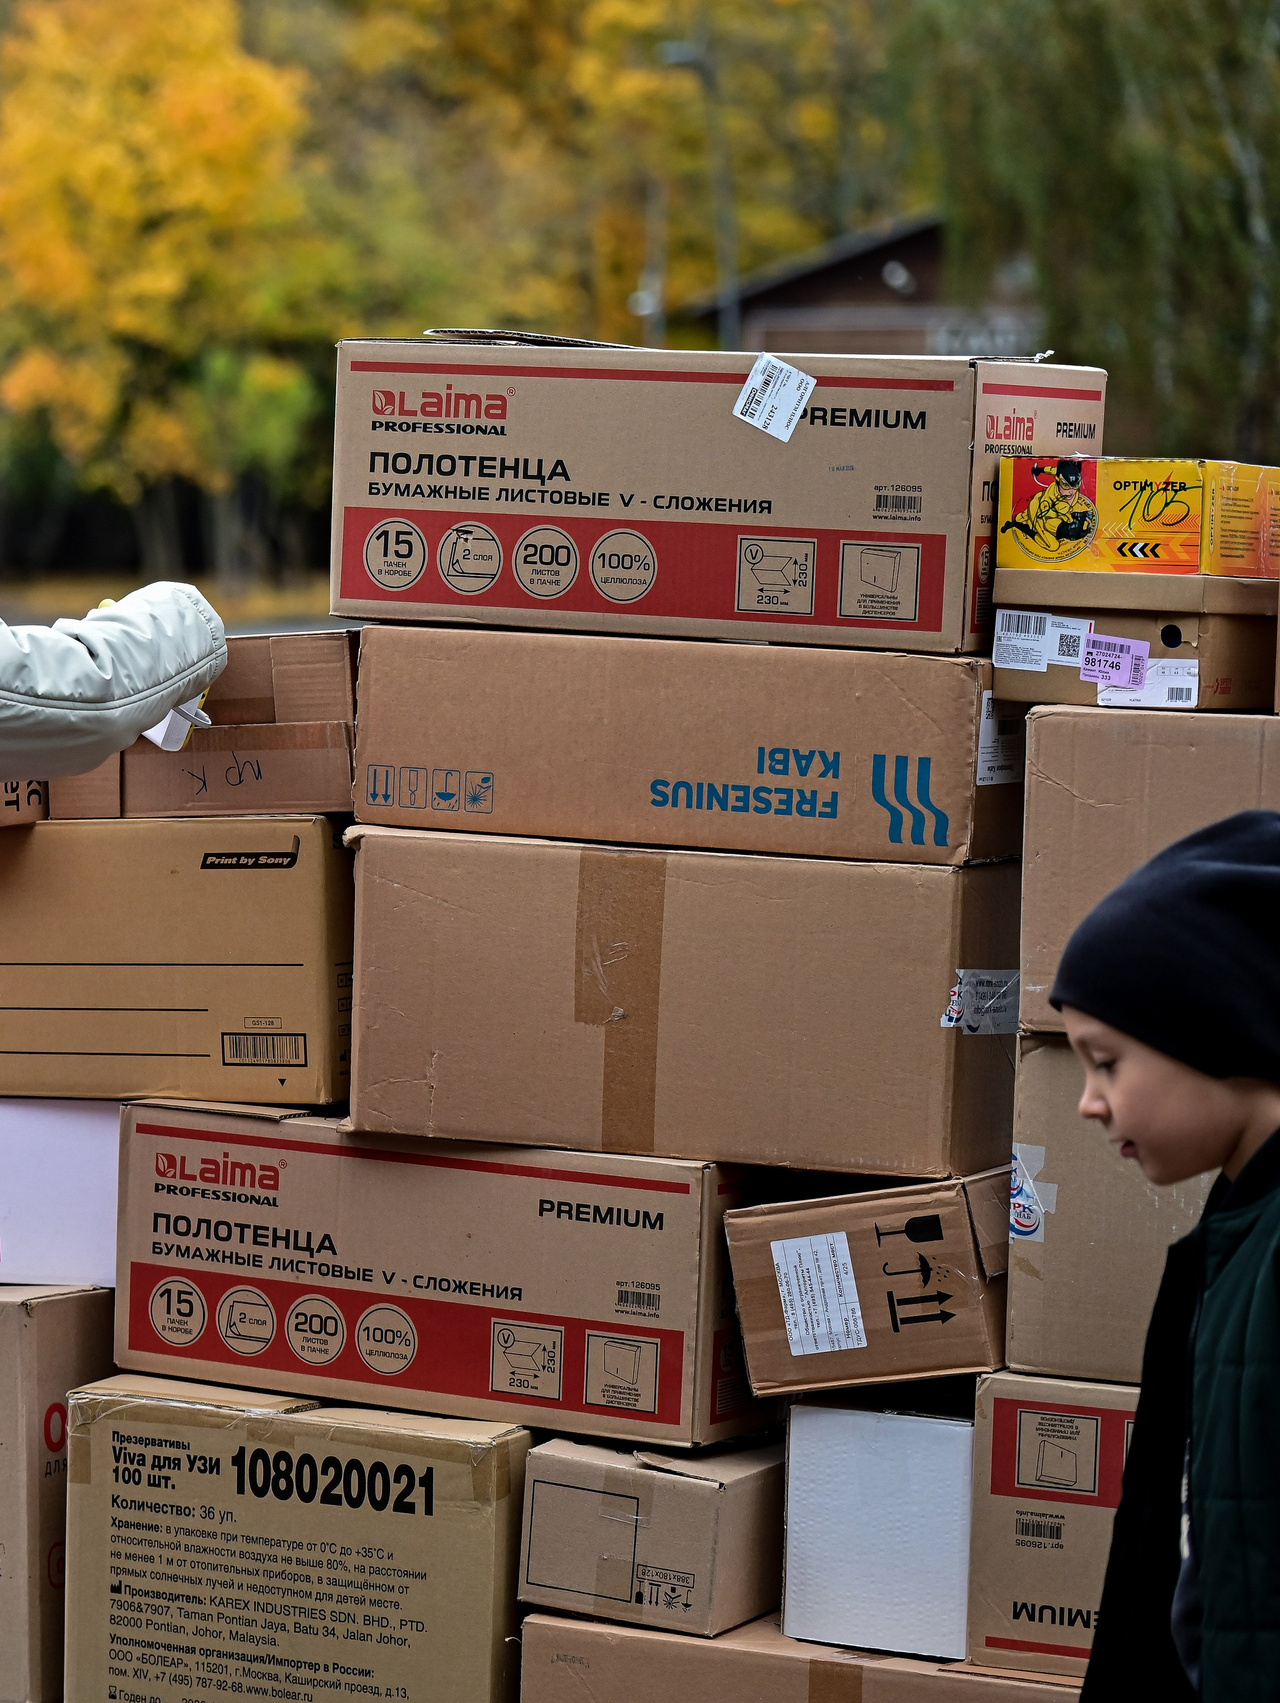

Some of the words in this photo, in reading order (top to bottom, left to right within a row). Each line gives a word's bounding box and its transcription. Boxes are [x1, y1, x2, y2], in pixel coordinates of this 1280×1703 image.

[398, 383, 508, 420] Laima
[371, 420, 507, 437] PROFESSIONAL
[994, 408, 1035, 441] Laima
[1055, 421, 1096, 440] PREMIUM
[984, 443, 1033, 455] PROFESSIONAL
[369, 451, 571, 485] ПОЛОТЕНЦА
[368, 481, 490, 501] БУМАЖНЫЕ
[495, 487, 610, 507] ЛИСТОВЫЕ
[619, 493, 635, 508] V
[653, 495, 772, 515] СЛОЖЕНИЯ
[873, 484, 923, 493] арт.126095
[375, 529, 413, 559] 15
[462, 548, 471, 561] 2
[472, 553, 493, 562] СЛОЯ
[523, 543, 571, 567] 200
[377, 568, 383, 576] В
[384, 569, 412, 577] КОРОБЕ
[383, 560, 407, 569] ПАЧЕК
[531, 568, 560, 577] ЛИСТОВ
[597, 552, 651, 571] 100%
[529, 577, 535, 585] В
[536, 578, 561, 587] ПАЧКЕ
[600, 577, 648, 587] ЦЕЛЛЮЛОЗА
[797, 563, 808, 588] 230
[756, 594, 779, 606] 230
[1084, 656, 1121, 671] 981746
[756, 746, 841, 780] KABI
[649, 778, 839, 820] FRESENIUS
[206, 856, 238, 864] Print
[239, 856, 256, 866] by
[257, 855, 291, 865] Sony
[180, 1151, 280, 1192] Laima
[154, 1182, 279, 1208] PROFESSIONAL
[538, 1198, 664, 1231] PREMIUM
[152, 1212, 338, 1259] ПОЛОТЕНЦА
[151, 1241, 263, 1268] БУМАЖНЫЕ
[268, 1256, 374, 1283] ЛИСТОВЫЕ
[381, 1270, 396, 1285] V
[412, 1274, 523, 1302] СЛОЖЕНИЯ
[615, 1280, 661, 1291] арт.126095
[158, 1287, 194, 1318] 15
[294, 1312, 343, 1337] 200
[362, 1326, 412, 1347] 100%
[112, 1430, 191, 1451] Презервативы
[111, 1445, 147, 1467] Viva
[150, 1454, 182, 1471] для
[186, 1453, 221, 1476] УЗИ
[112, 1465, 142, 1486] 100
[147, 1473, 176, 1490] шт.
[231, 1445, 434, 1517] 108020021
[111, 1493, 196, 1518] Количество:
[199, 1505, 215, 1520] 36
[218, 1510, 237, 1525] уп.
[1015, 1538, 1064, 1550] арт.126095
[641, 1568, 691, 1585] 388x180x128
[124, 1584, 207, 1606] Производитель:
[209, 1595, 251, 1611] KAREX
[253, 1600, 327, 1621] INDUSTRIES
[329, 1610, 359, 1625] SDN.
[363, 1614, 396, 1631] BHD.,
[399, 1618, 428, 1633] PTD.
[1012, 1601, 1102, 1631] MIUM
[109, 1598, 174, 1619] 7906&7907,
[176, 1606, 214, 1623] Taman
[216, 1611, 258, 1628] Pontian
[260, 1617, 290, 1634] Jaya,
[293, 1621, 319, 1636] Batu
[321, 1625, 339, 1640] 34,
[342, 1628, 373, 1643] Jalan
[375, 1632, 411, 1649] Johor,
[109, 1614, 143, 1629] 82000
[145, 1618, 189, 1637] Pontian,
[191, 1624, 226, 1642] Johor,
[229, 1629, 280, 1647] Malaysia.
[108, 1666, 130, 1678] пом.
[132, 1667, 152, 1682] XIV,
[154, 1671, 167, 1682] +7
[168, 1672, 193, 1689] (495)
